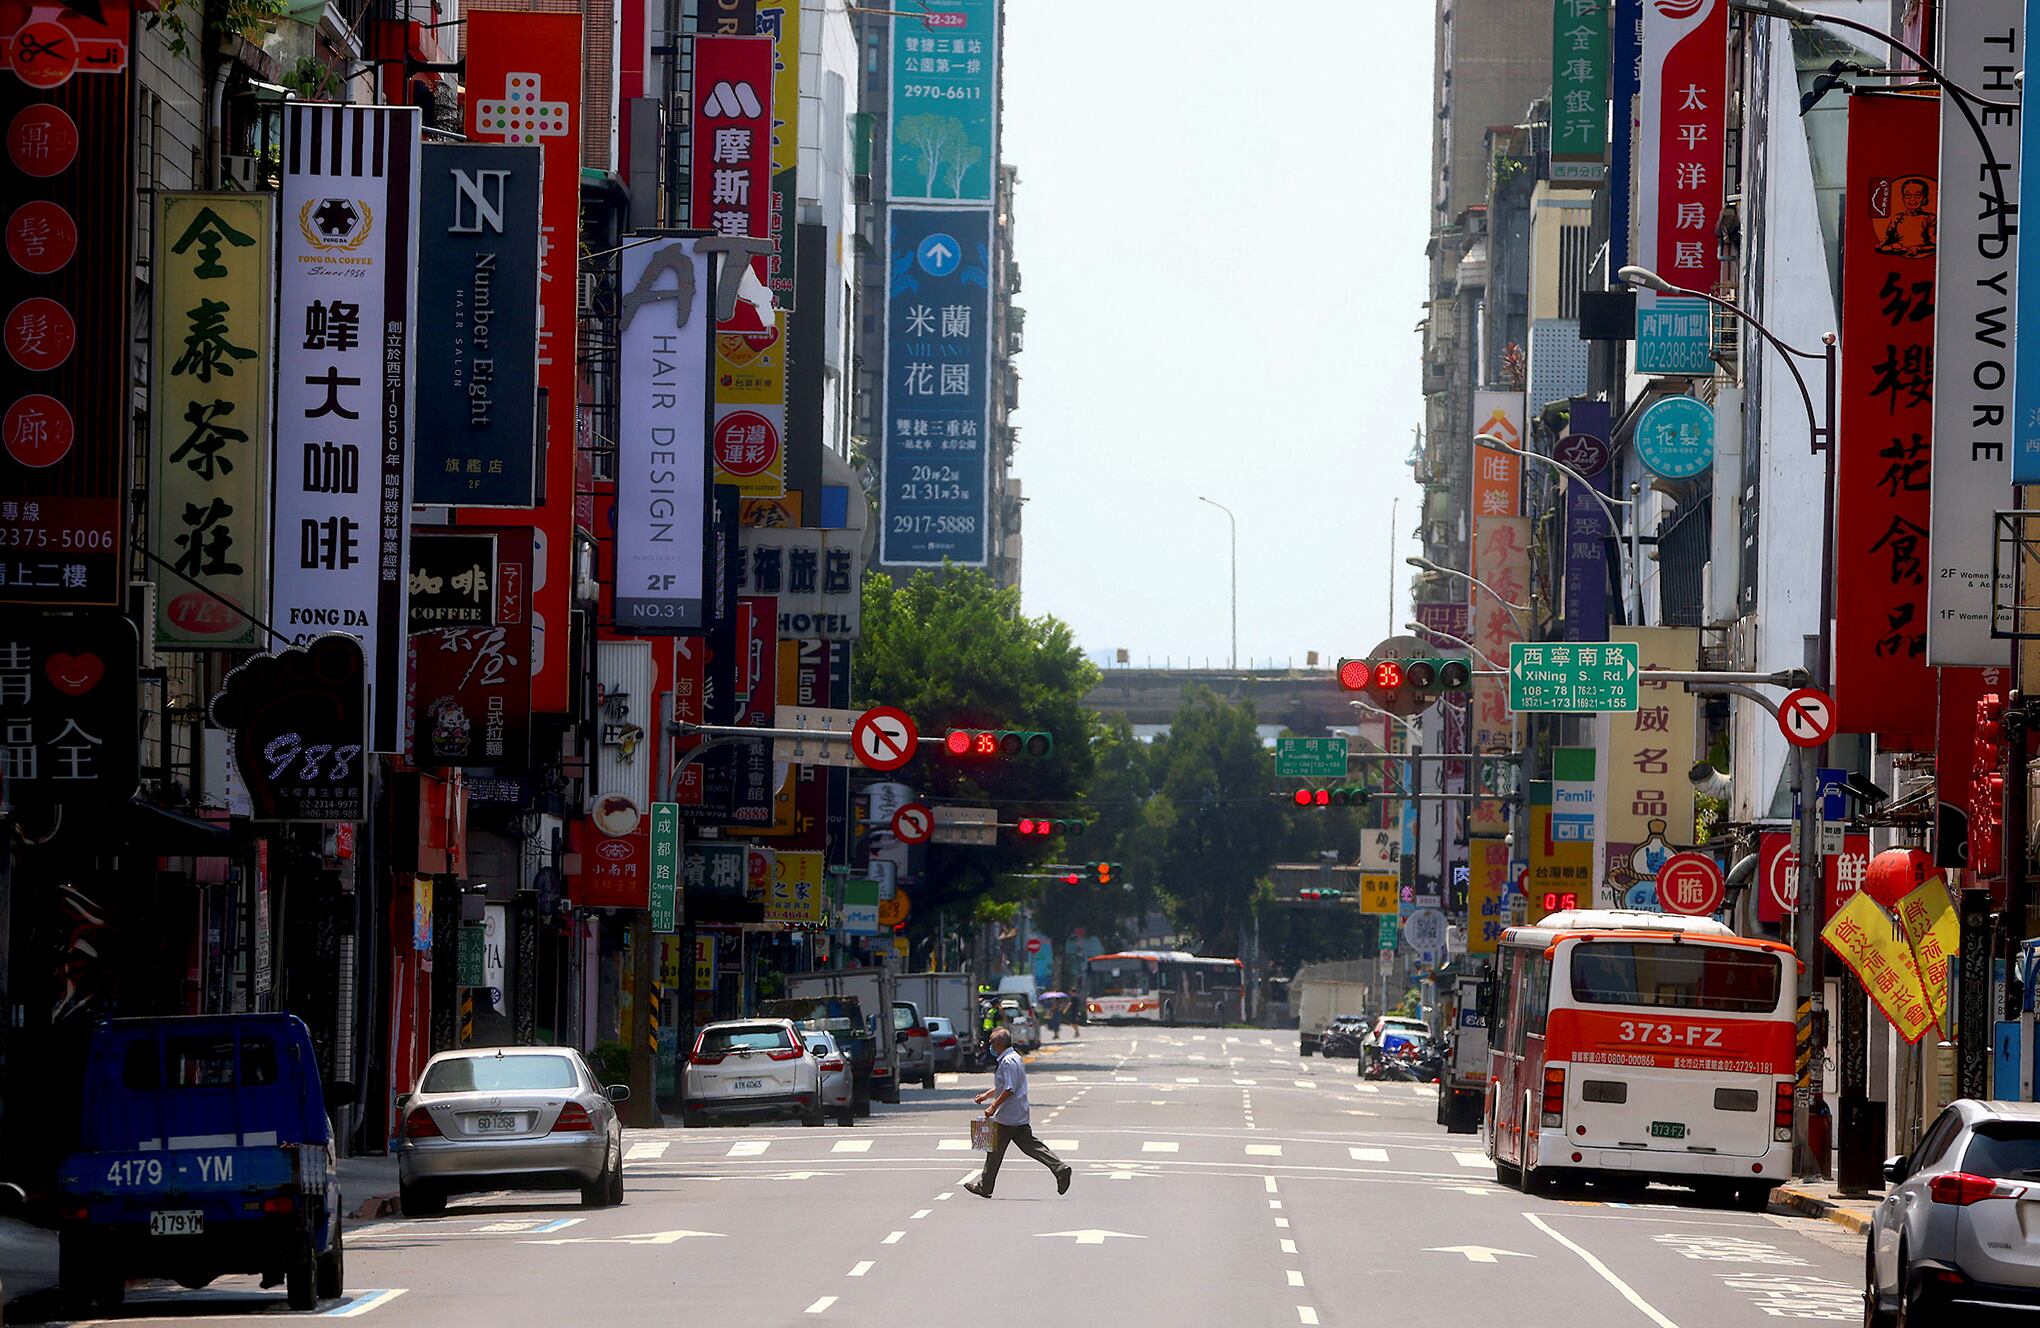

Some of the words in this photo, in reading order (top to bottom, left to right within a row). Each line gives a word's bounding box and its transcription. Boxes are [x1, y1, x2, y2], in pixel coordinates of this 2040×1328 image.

[905, 37, 981, 54] 雙捷三重站
[905, 57, 981, 74] 公園第一排
[1982, 28, 2015, 126] THE
[904, 85, 981, 100] 2970-6611
[1554, 167, 1602, 180] 西門分行
[1674, 83, 1708, 269] 太平洋房屋
[298, 255, 323, 264] FONG
[325, 256, 337, 264] DA
[338, 257, 373, 266] COFFEE
[456, 289, 464, 328] HAIR
[473, 251, 497, 348] Number
[906, 304, 971, 338] 米蘭
[1972, 163, 2011, 462] LADYWORE
[1643, 314, 1711, 338] 西門加盟
[454, 338, 462, 387] SALON
[653, 336, 677, 409] HAIR
[904, 361, 970, 396] 花園
[170, 207, 257, 577] 全泰茶莊
[386, 320, 403, 467] 創立於西元1956年
[468, 357, 493, 426] Eight
[303, 301, 360, 569] 蜂大咖啡
[896, 418, 978, 437] 雙捷三重站
[467, 479, 482, 489] 2F
[650, 428, 676, 541] DESIGN
[2, 501, 39, 522] 專線
[894, 515, 977, 534] 2917-5888
[0, 529, 112, 548] 2375-5006
[409, 563, 489, 603] 咖啡
[648, 575, 677, 590] 2F
[1941, 569, 1957, 578] 2F
[1961, 572, 1989, 580] Women
[503, 567, 519, 620] ラーメン
[289, 608, 340, 625] FONG
[344, 610, 368, 626] DA
[410, 607, 482, 621] COFFEE
[633, 603, 684, 618] NO.31
[1941, 611, 1956, 621] 1F
[1523, 647, 1625, 667] 西寧南路
[1379, 665, 1399, 686] 35
[1526, 671, 1557, 684] XiNing
[1578, 671, 1591, 681] S.
[1603, 671, 1625, 681] Rd.
[486, 696, 504, 757] 日式拉麵
[977, 735, 994, 752] 35
[264, 732, 361, 781] 988
[657, 819, 672, 880] 成都路
[652, 883, 673, 891] Cheng
[1619, 1021, 1723, 1048] 373-FZ
[1653, 1124, 1684, 1137] 373-FZ
[107, 1159, 163, 1187] 4179
[197, 1155, 233, 1182] YM
[150, 1215, 204, 1234] 4179-YM
